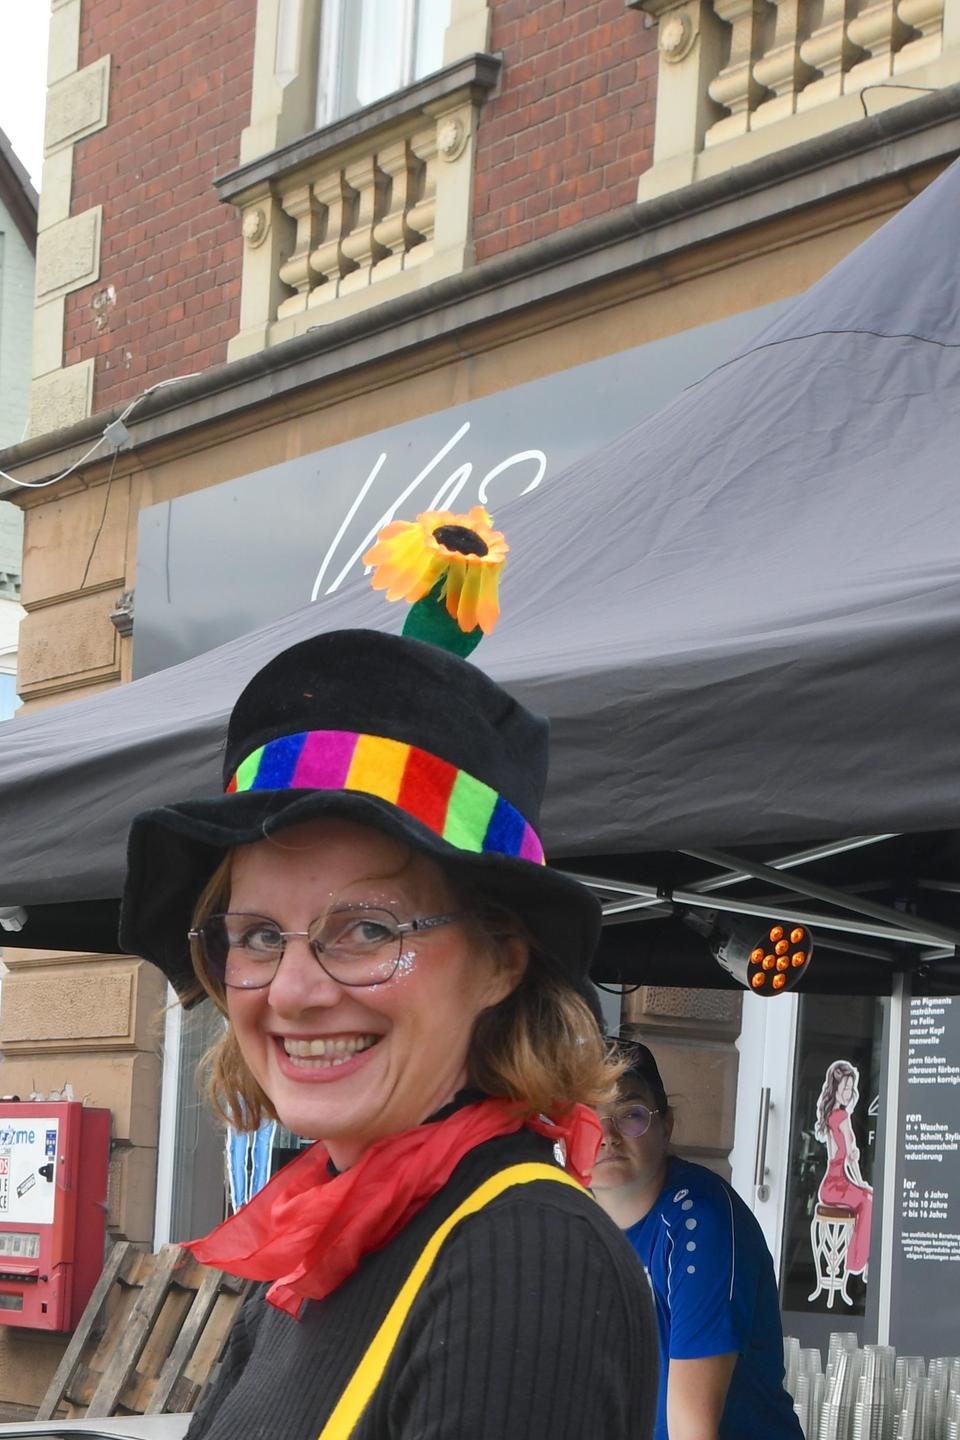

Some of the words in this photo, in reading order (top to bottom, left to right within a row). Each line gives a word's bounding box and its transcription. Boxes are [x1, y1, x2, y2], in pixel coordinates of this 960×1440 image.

[922, 997, 952, 1007] Pigments
[929, 1026, 945, 1036] Kopf
[906, 1113, 922, 1122] ren
[920, 1123, 948, 1132] Waschen
[909, 1190, 919, 1198] bis
[924, 1190, 929, 1198] 6
[930, 1191, 949, 1199] Jahre
[909, 1200, 918, 1208] bis
[921, 1200, 929, 1208] 10
[930, 1200, 948, 1209] Jahre
[908, 1210, 918, 1218] bis
[920, 1210, 928, 1218] 16
[929, 1211, 947, 1219] Jahre
